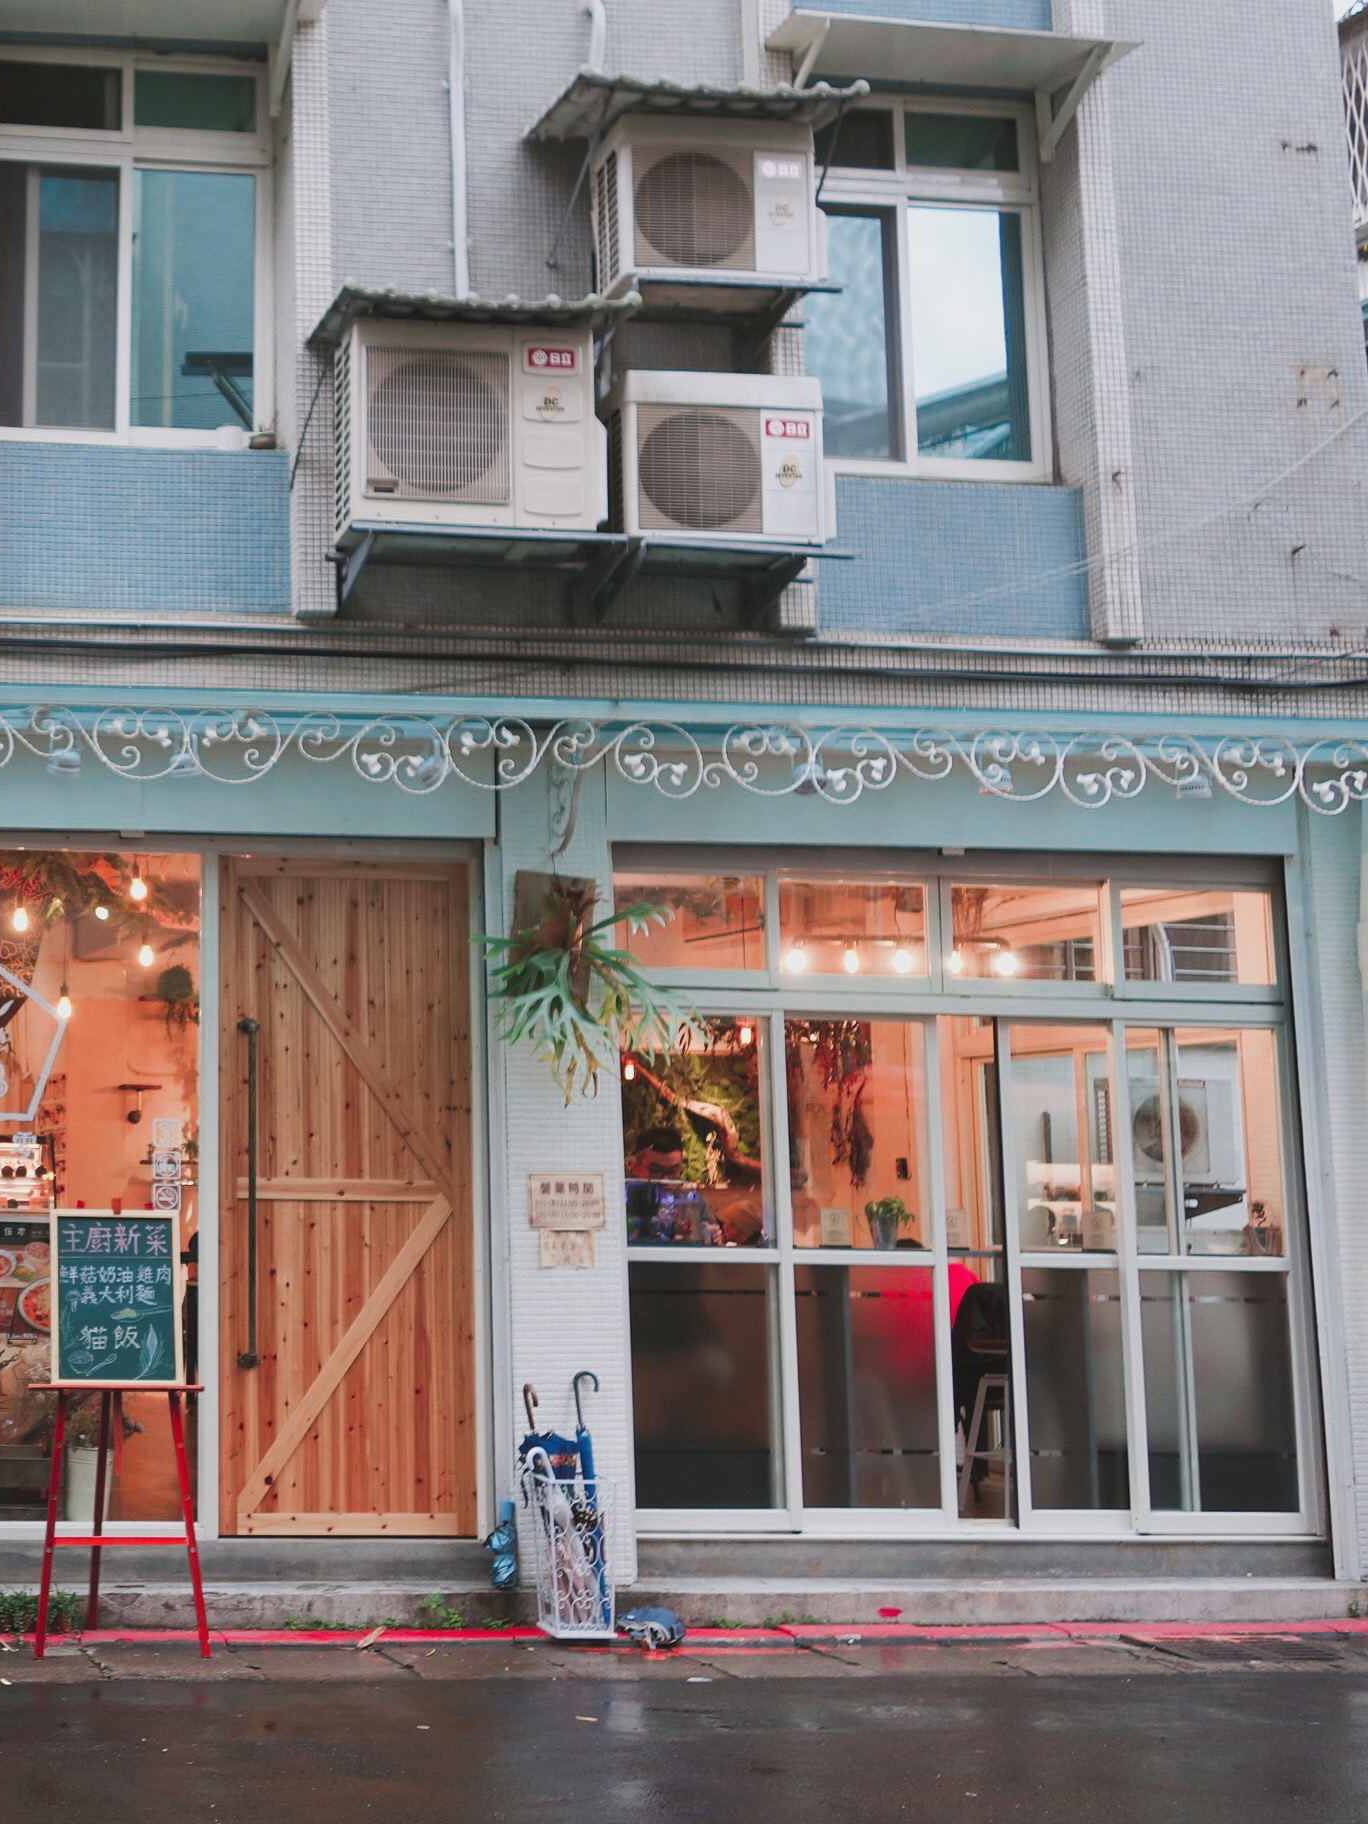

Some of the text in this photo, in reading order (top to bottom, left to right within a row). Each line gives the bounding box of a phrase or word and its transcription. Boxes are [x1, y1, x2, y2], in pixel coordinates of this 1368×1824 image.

[544, 397, 558, 406] DC
[783, 464, 797, 473] DC
[60, 1222, 168, 1256] 主廚新菜
[59, 1265, 171, 1285] 鮮菇奶油雞肉
[81, 1285, 157, 1305] 義大利麵
[78, 1324, 141, 1350] 貓飯
